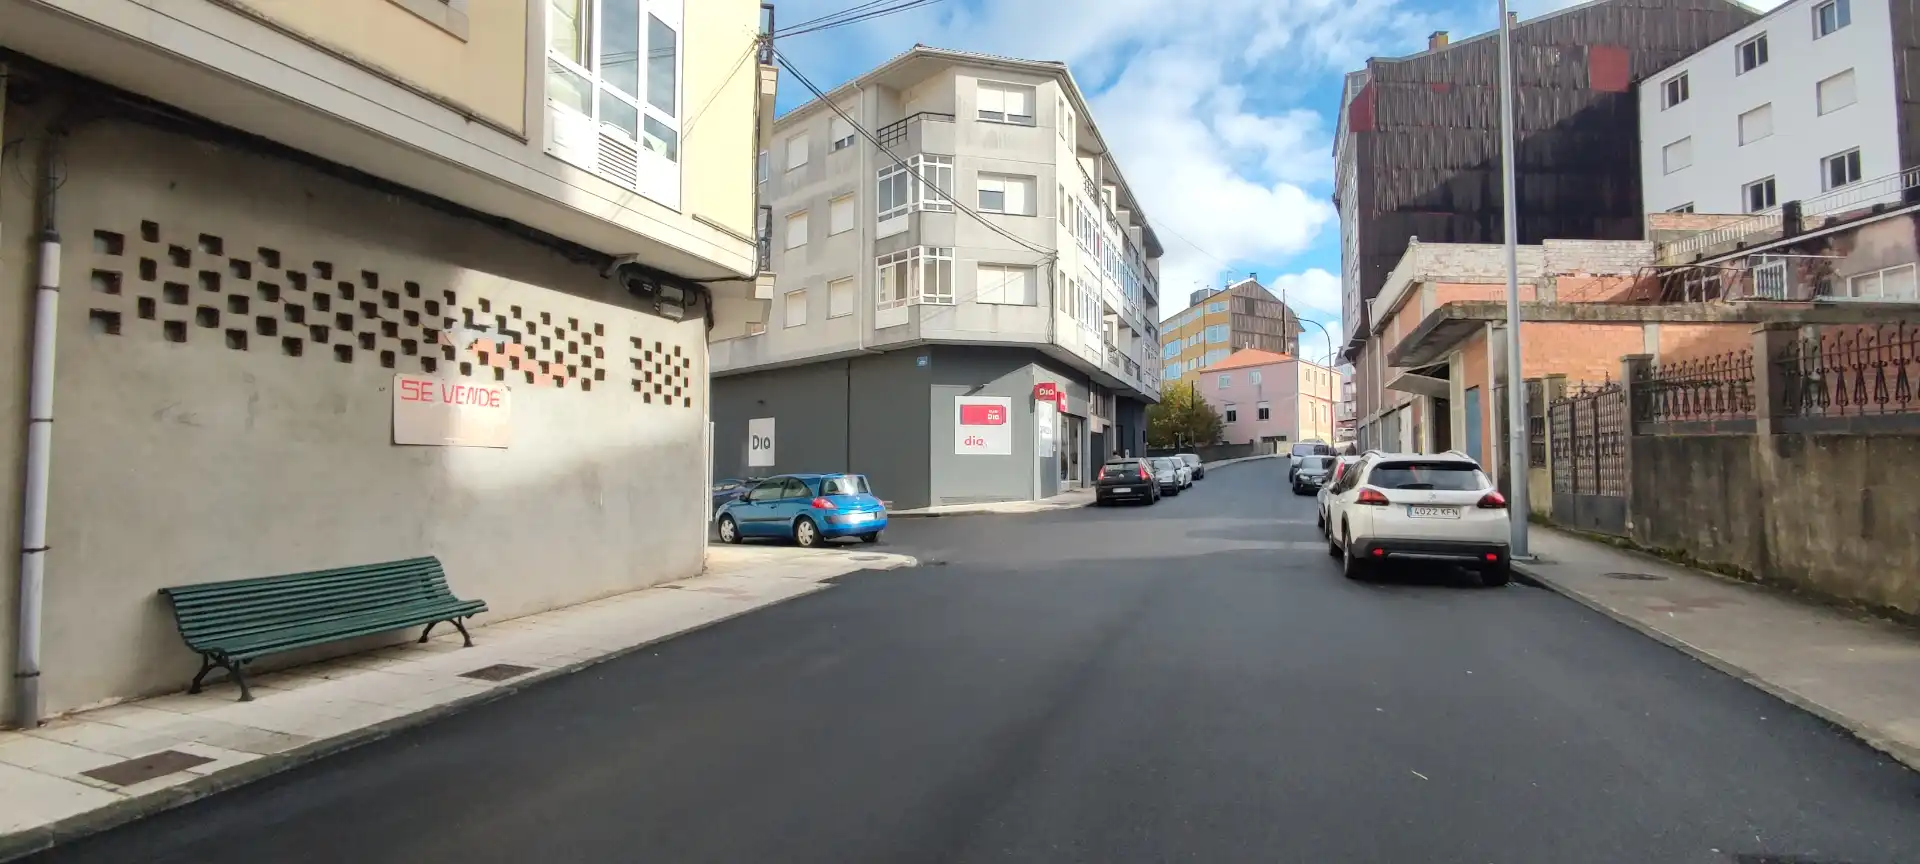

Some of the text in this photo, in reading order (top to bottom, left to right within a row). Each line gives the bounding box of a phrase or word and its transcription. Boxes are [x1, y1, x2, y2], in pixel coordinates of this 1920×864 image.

[401, 379, 501, 408] SE VENDE
[1414, 507, 1458, 516] 4022 KFN
